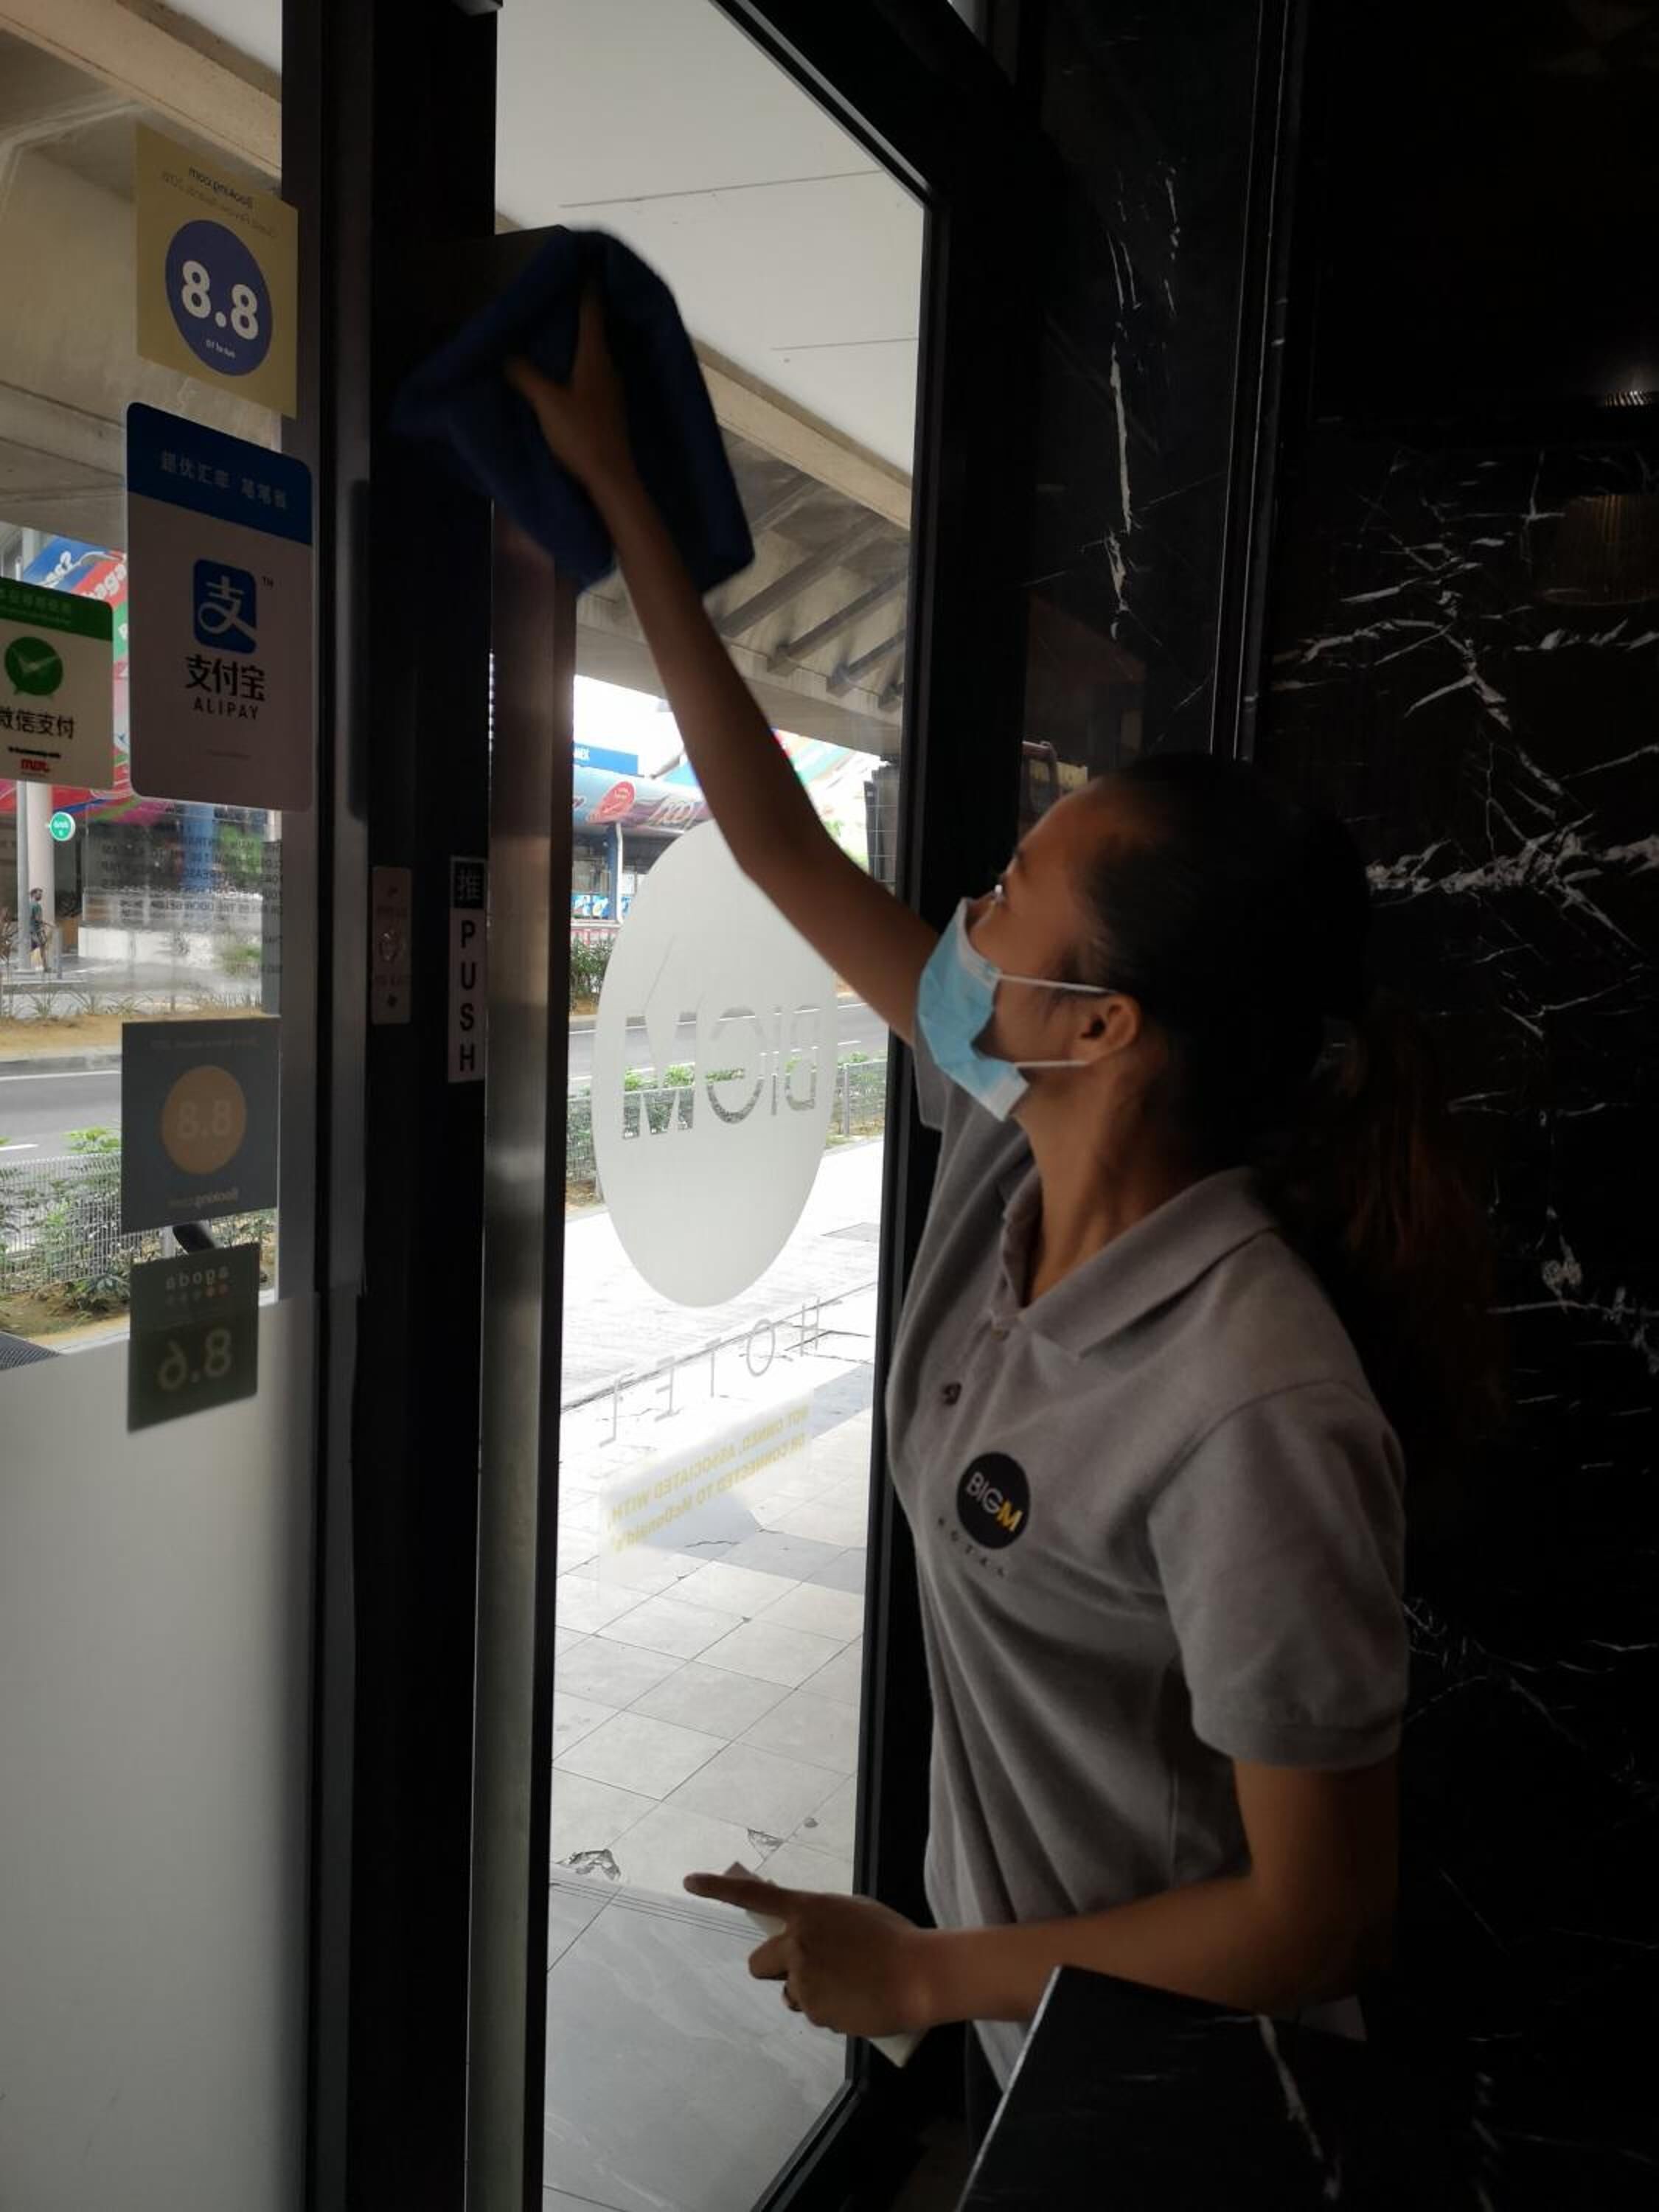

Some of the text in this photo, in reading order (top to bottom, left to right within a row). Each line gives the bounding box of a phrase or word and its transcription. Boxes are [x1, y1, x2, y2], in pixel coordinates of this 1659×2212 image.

[185, 653, 266, 703] 支付宝
[192, 695, 260, 720] ALIPAY
[459, 919, 476, 1072] PUSH
[967, 1471, 1023, 1533] BIGM
